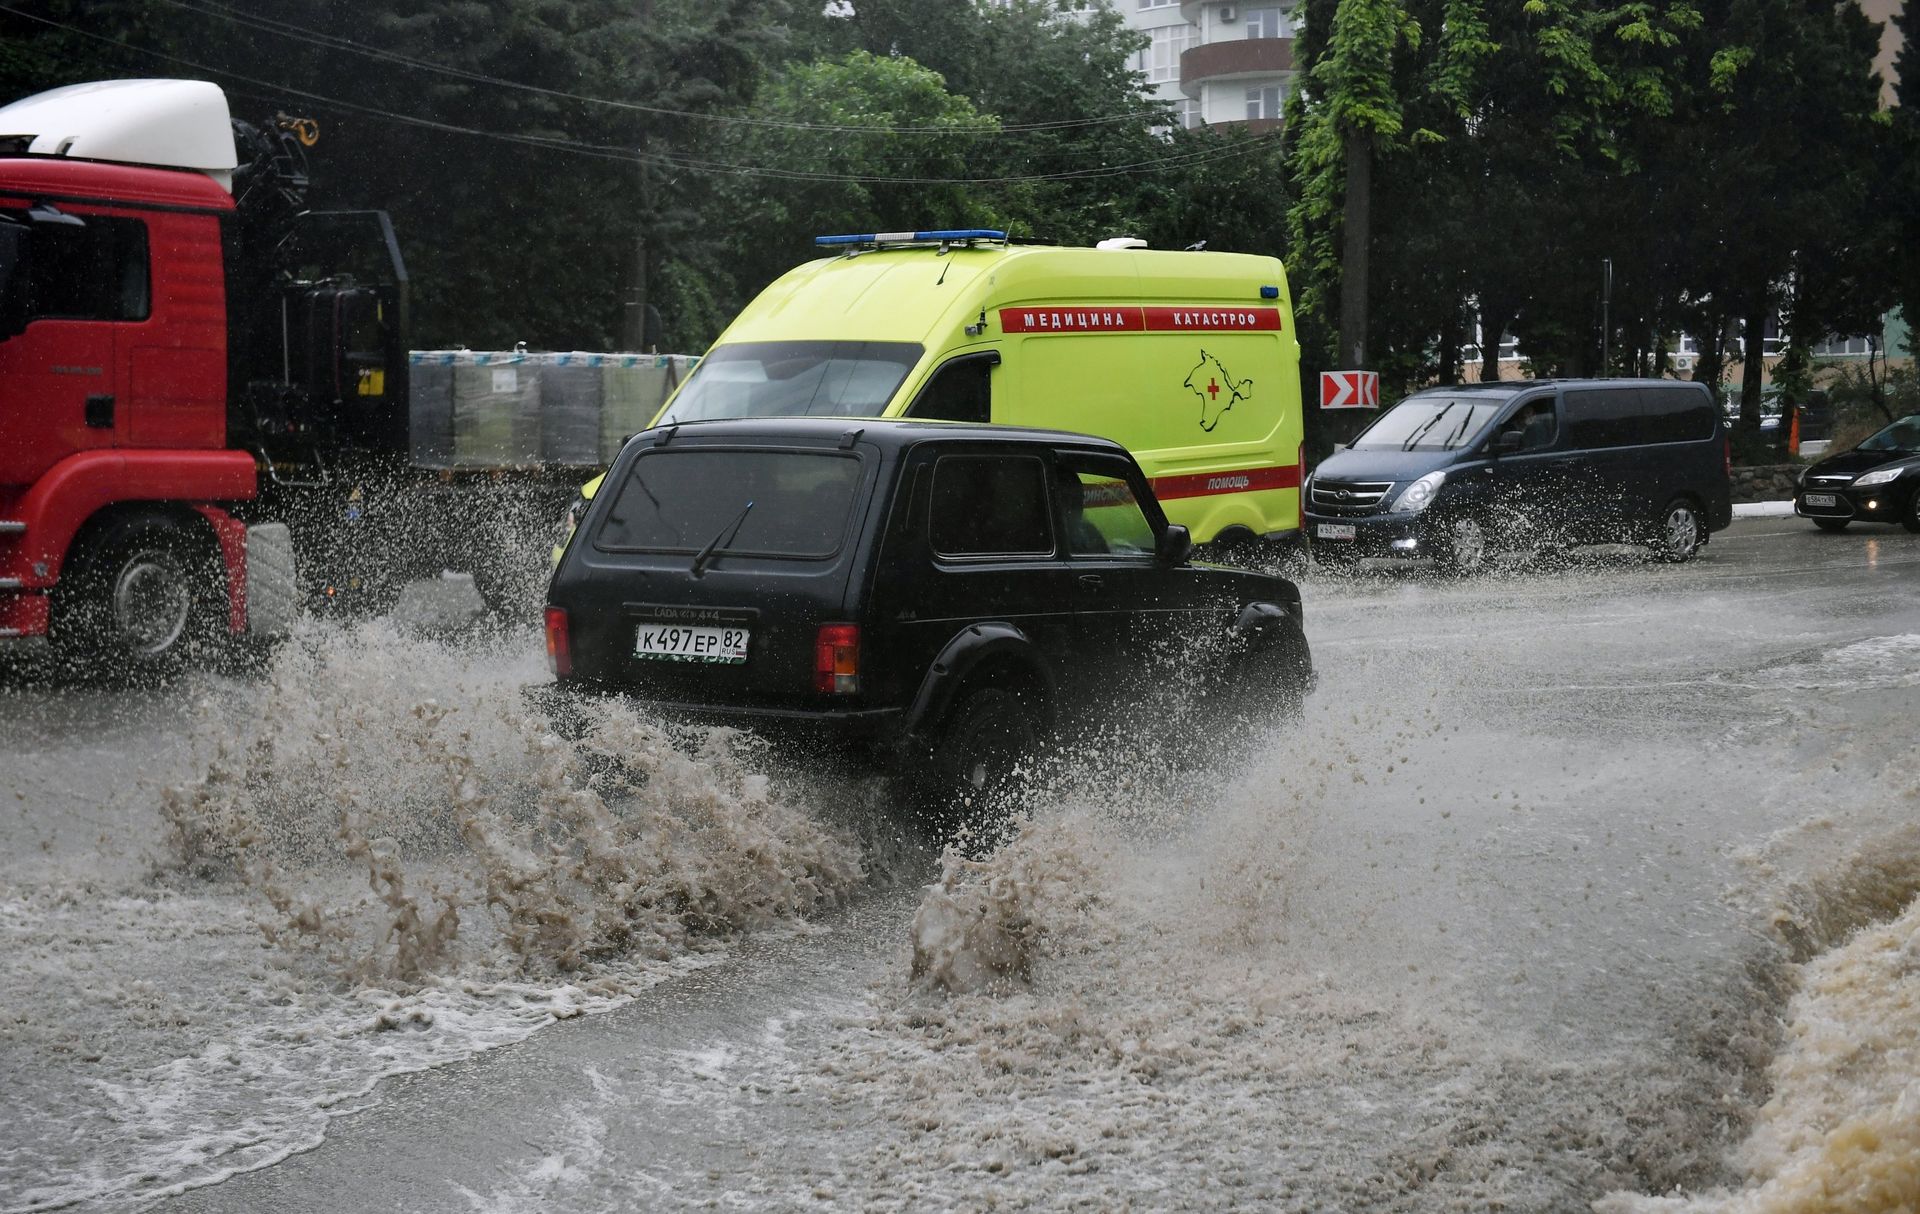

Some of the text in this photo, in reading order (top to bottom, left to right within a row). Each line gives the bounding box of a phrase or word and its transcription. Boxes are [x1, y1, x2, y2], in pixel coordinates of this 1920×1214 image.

[1023, 312, 1256, 329] МЕДИЦИНА КАТАСТРОФ
[1207, 475, 1249, 490] ПОМОЩЬ
[654, 606, 678, 618] LADA
[723, 630, 743, 648] 82
